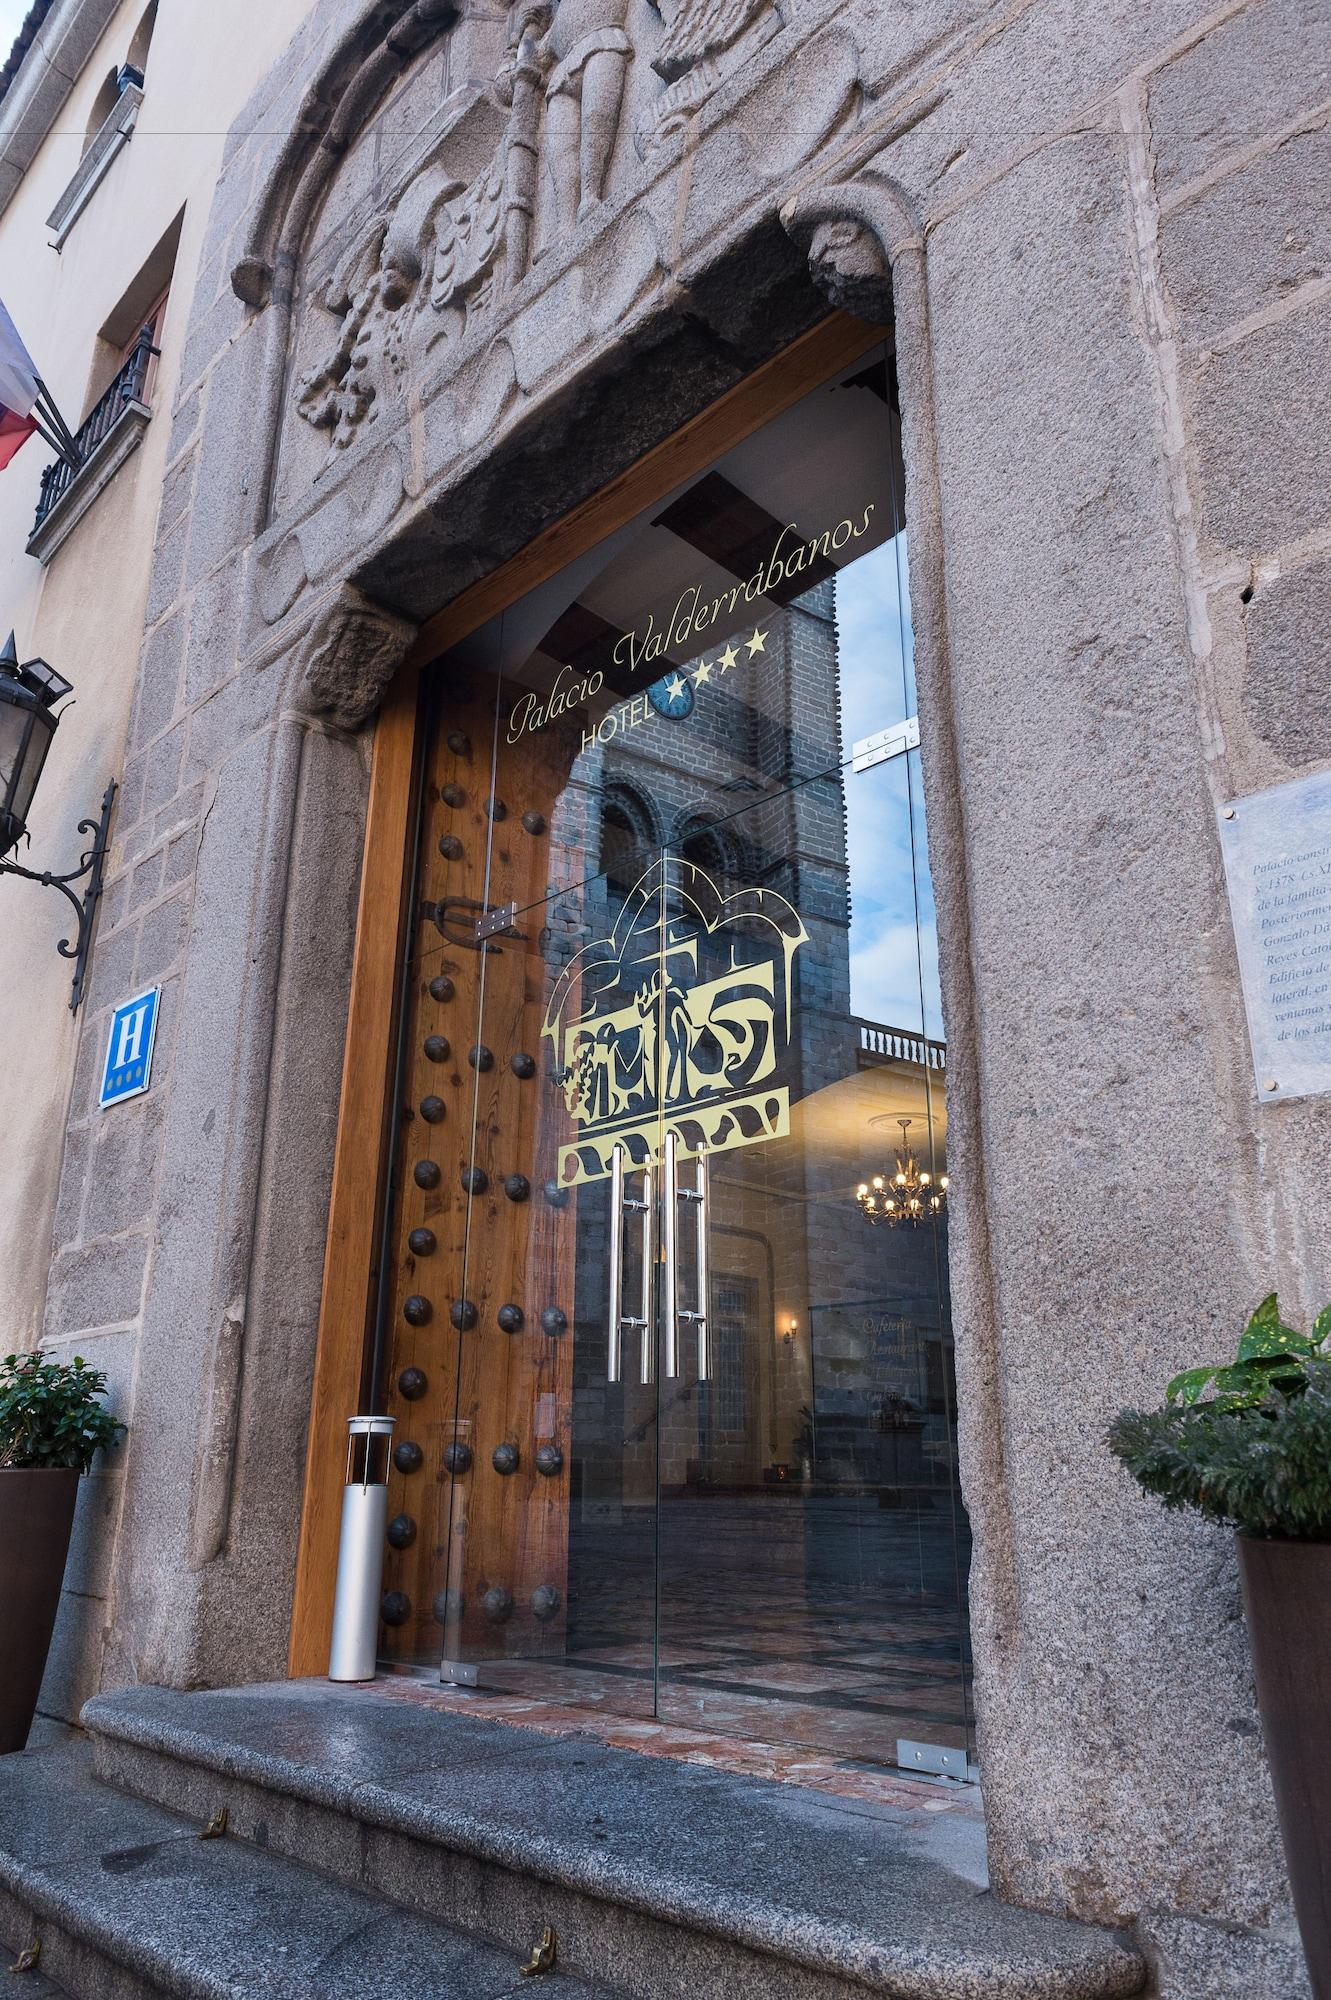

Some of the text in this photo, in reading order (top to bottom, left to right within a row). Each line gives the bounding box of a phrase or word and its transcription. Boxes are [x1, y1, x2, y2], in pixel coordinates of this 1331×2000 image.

[507, 503, 874, 744] Palacio Valderrábanos
[581, 694, 656, 754] HOTEL
[1253, 857, 1294, 875] Palacio
[1257, 900, 1271, 911] de
[1273, 896, 1284, 907] la
[1288, 886, 1326, 905] familia
[1264, 928, 1310, 947] Gonzalo
[1267, 951, 1297, 967] Reyes
[1269, 961, 1330, 985] Edificio de
[1314, 983, 1328, 995] en
[1275, 1004, 1324, 1022] ventanas
[112, 1004, 149, 1071] H
[1277, 1029, 1291, 1041] de
[1294, 1026, 1310, 1038] los
